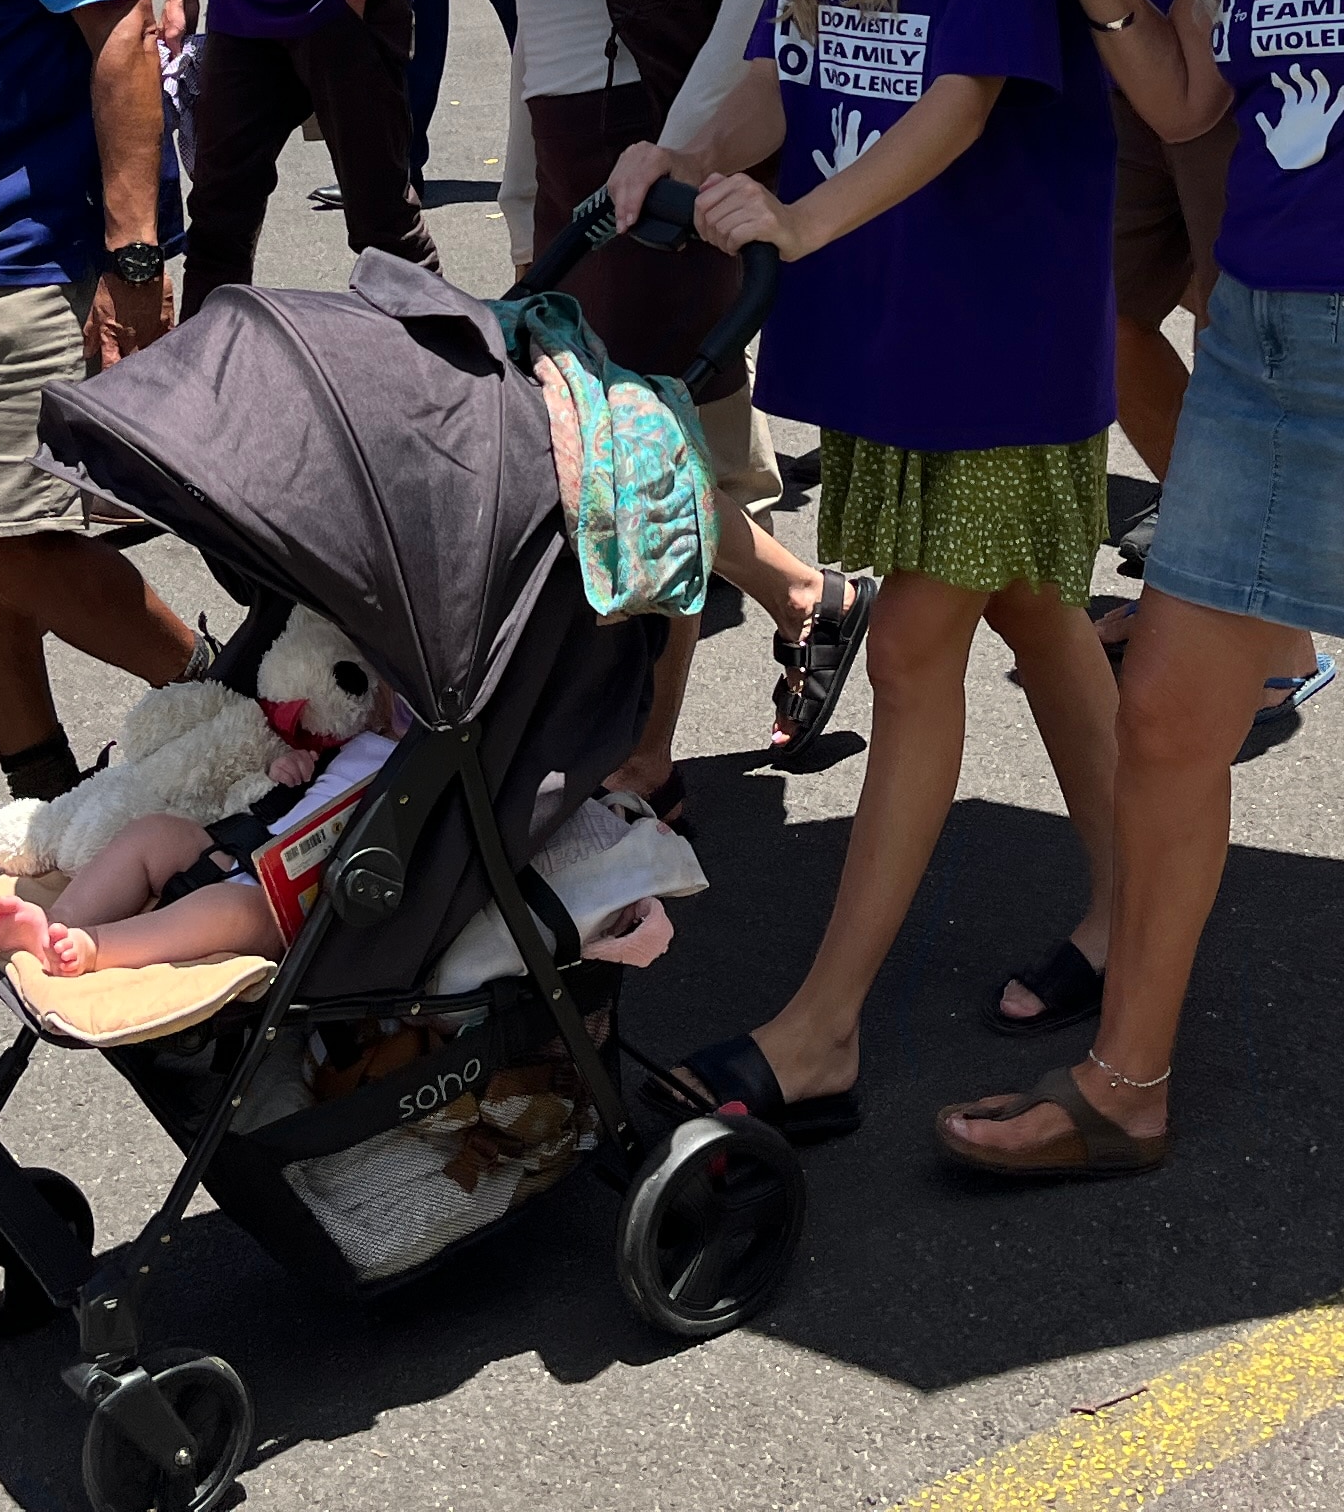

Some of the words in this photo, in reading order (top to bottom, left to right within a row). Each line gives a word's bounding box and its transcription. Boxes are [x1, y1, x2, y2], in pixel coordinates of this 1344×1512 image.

[821, 11, 908, 36] DOMESTIC
[914, 28, 923, 38] &
[1234, 9, 1248, 22] to
[824, 40, 920, 66] FAMILY
[824, 68, 918, 97] VIOLENCE
